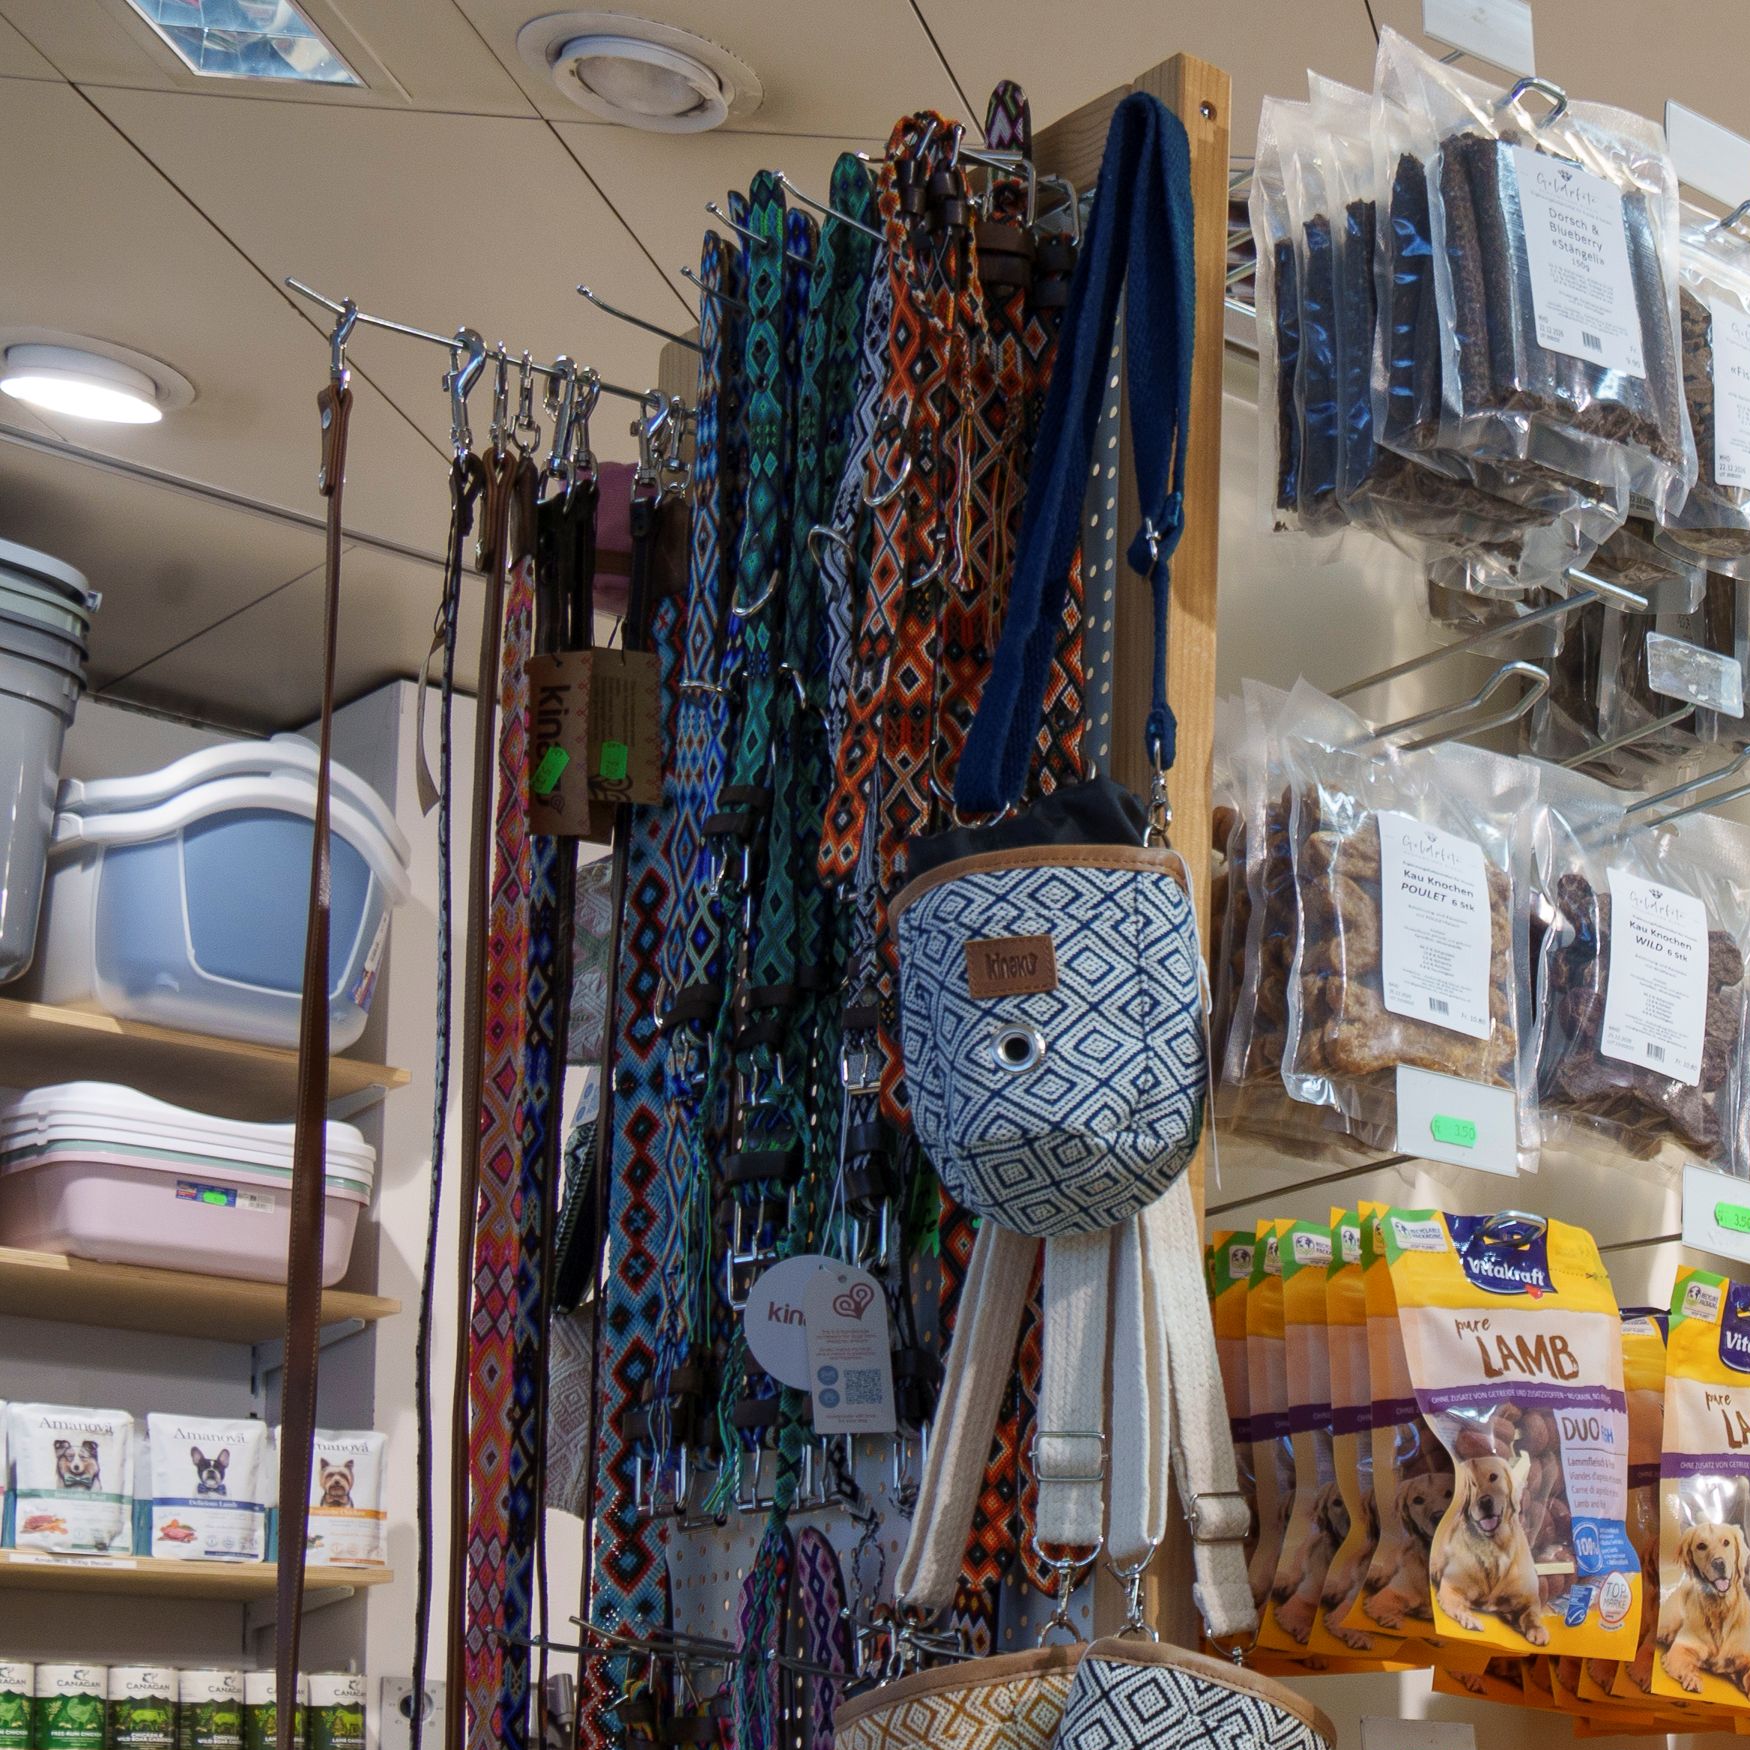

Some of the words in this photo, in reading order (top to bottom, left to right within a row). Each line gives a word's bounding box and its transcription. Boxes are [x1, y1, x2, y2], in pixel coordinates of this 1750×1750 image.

[1549, 207, 1588, 233] Dorsch
[1549, 222, 1603, 252] Blueberry
[1401, 882, 1447, 903] POULET
[1460, 901, 1475, 912] Stk
[1403, 869, 1425, 884] Kau
[1427, 876, 1474, 898] Knochen
[1629, 919, 1648, 935] Kau
[1651, 926, 1692, 951] Knochen
[1635, 935, 1664, 952] WILD
[1675, 951, 1688, 962] Stk
[1467, 1255, 1545, 1288] Vitakraft
[1455, 1315, 1490, 1340] pure
[1475, 1333, 1580, 1383] LAMB
[1706, 1389, 1732, 1409] pure
[1562, 1417, 1599, 1441] DUO
[57, 1678, 101, 1688] CANAGAN
